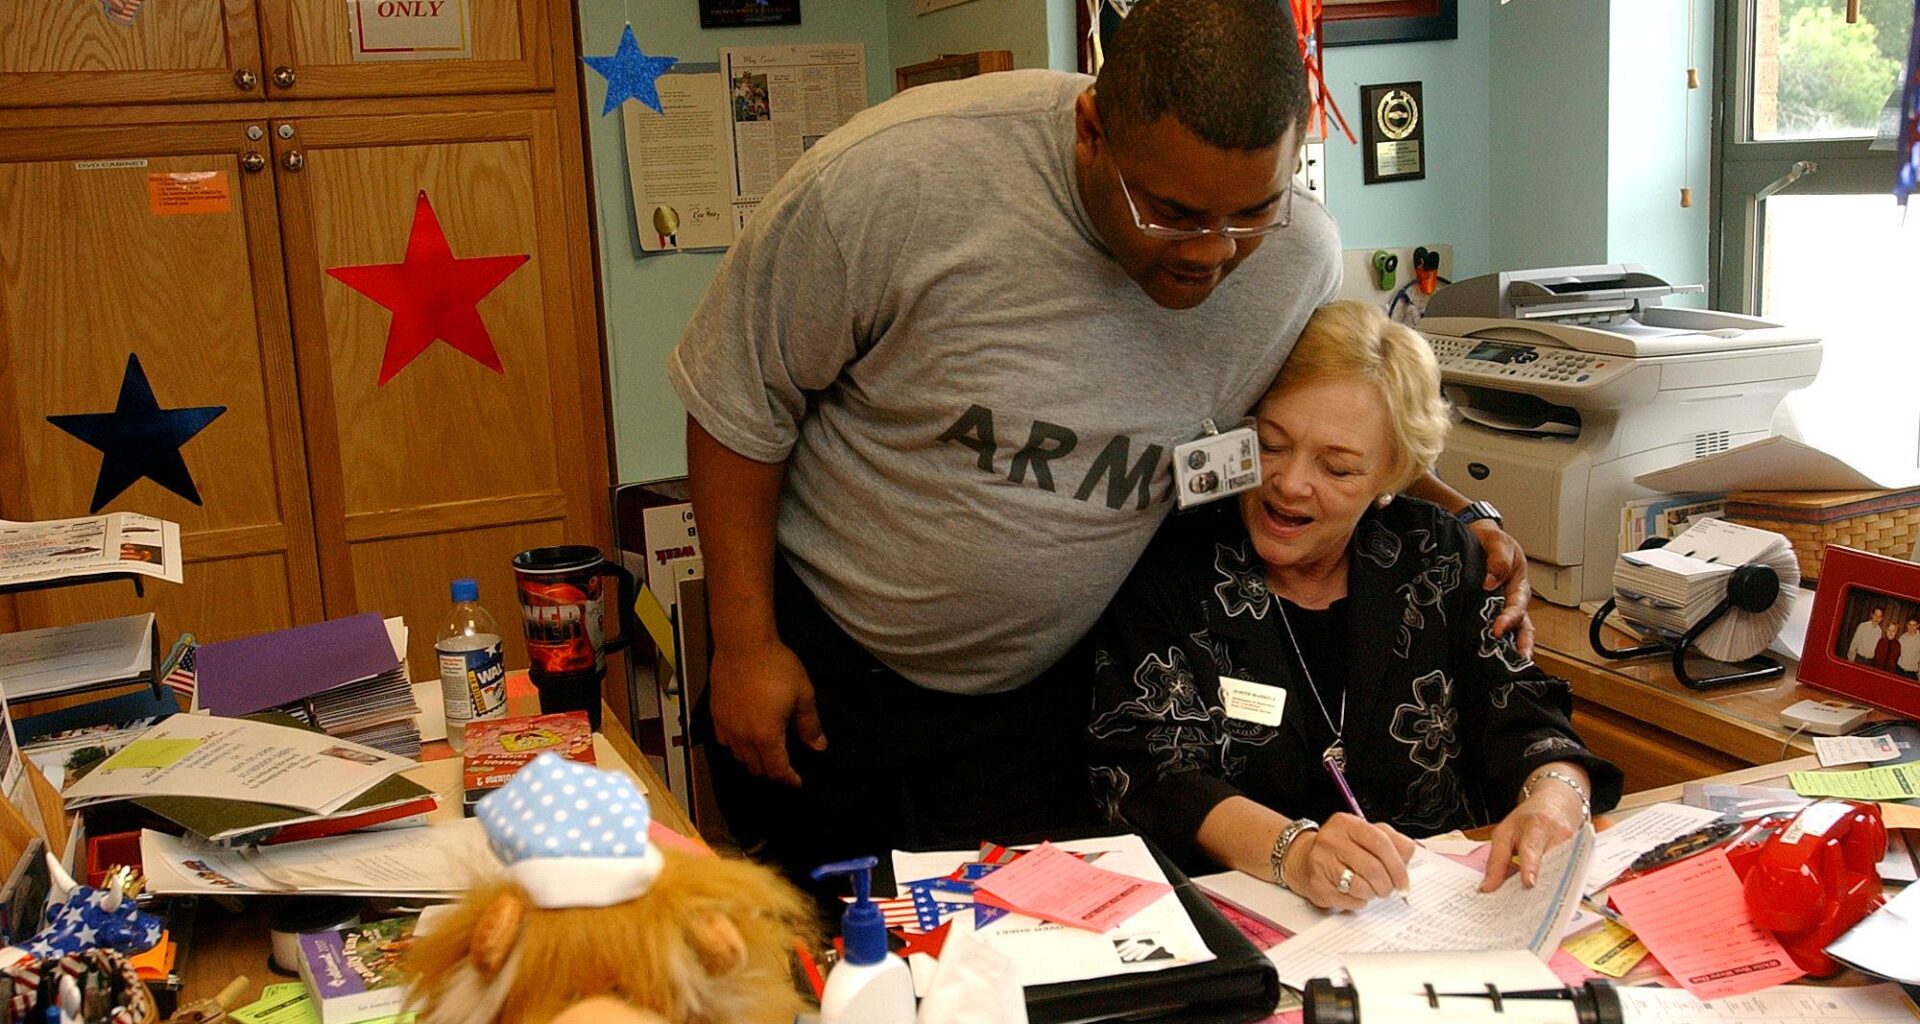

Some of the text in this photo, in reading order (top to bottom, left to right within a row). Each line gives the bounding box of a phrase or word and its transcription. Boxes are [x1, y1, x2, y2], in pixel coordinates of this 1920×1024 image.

[377, 0, 446, 18] ONLY
[935, 404, 1173, 512] ARM
[655, 545, 696, 566] week
